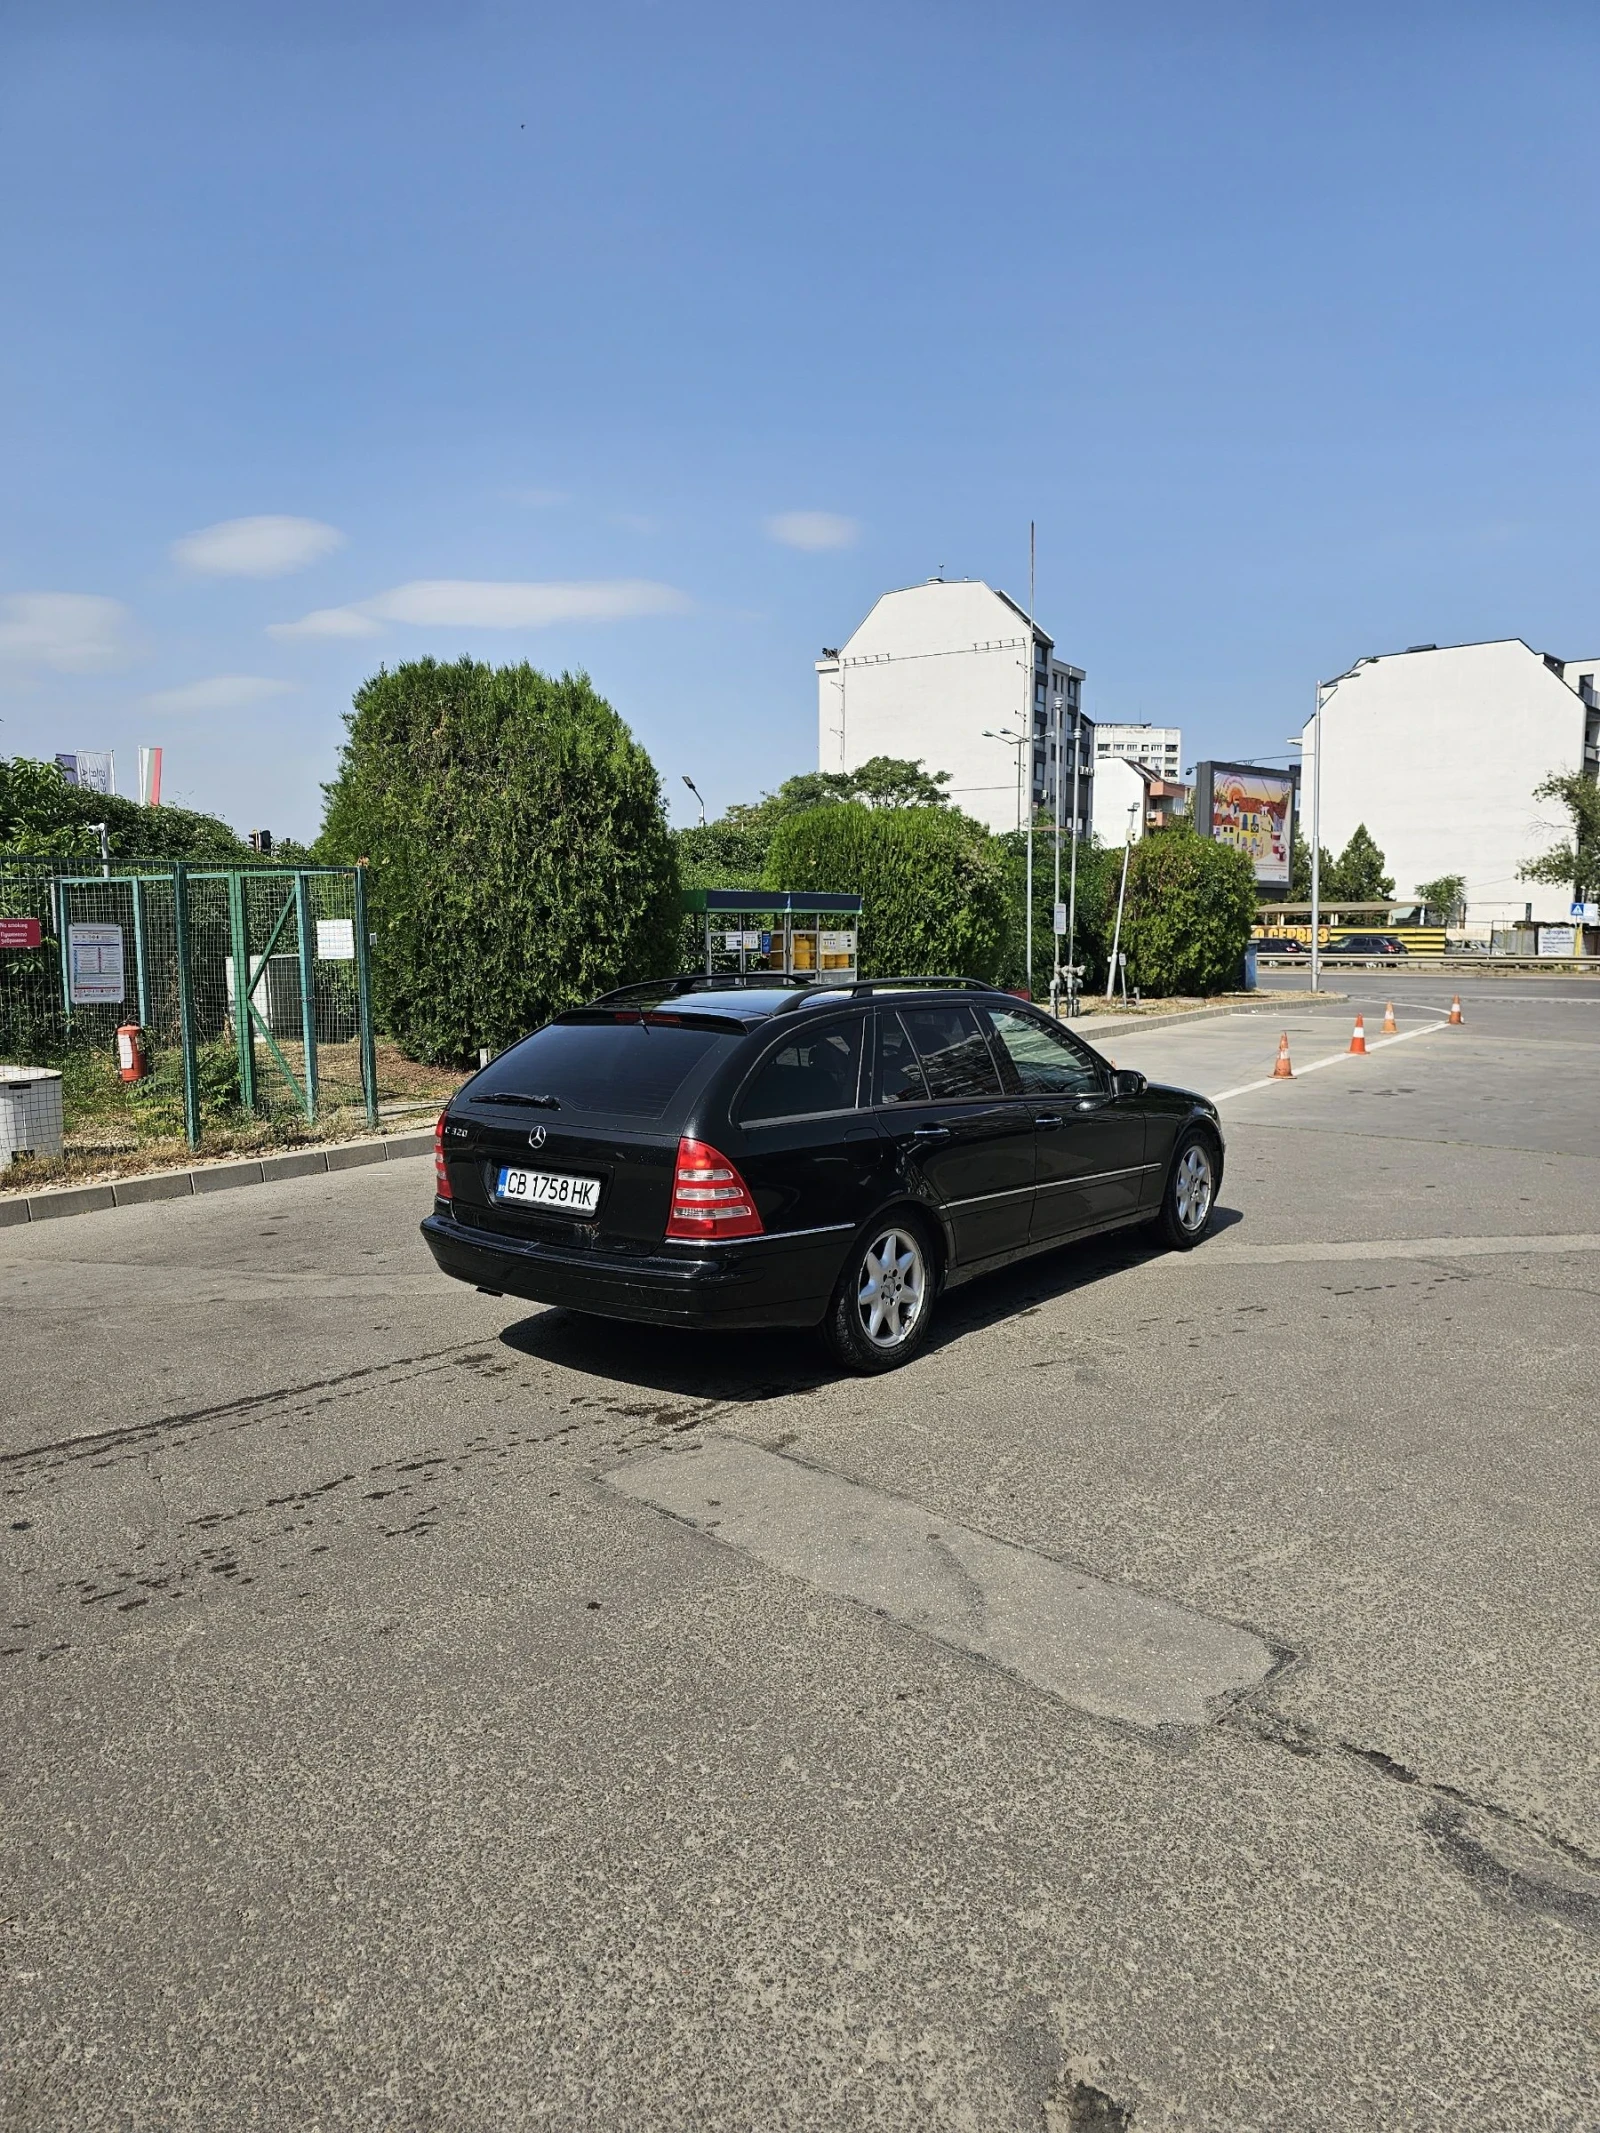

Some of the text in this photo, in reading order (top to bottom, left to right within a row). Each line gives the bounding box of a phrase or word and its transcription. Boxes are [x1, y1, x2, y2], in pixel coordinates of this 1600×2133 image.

[451, 1127, 468, 1137] 320
[508, 1172, 595, 1206] CB 1758 HK
